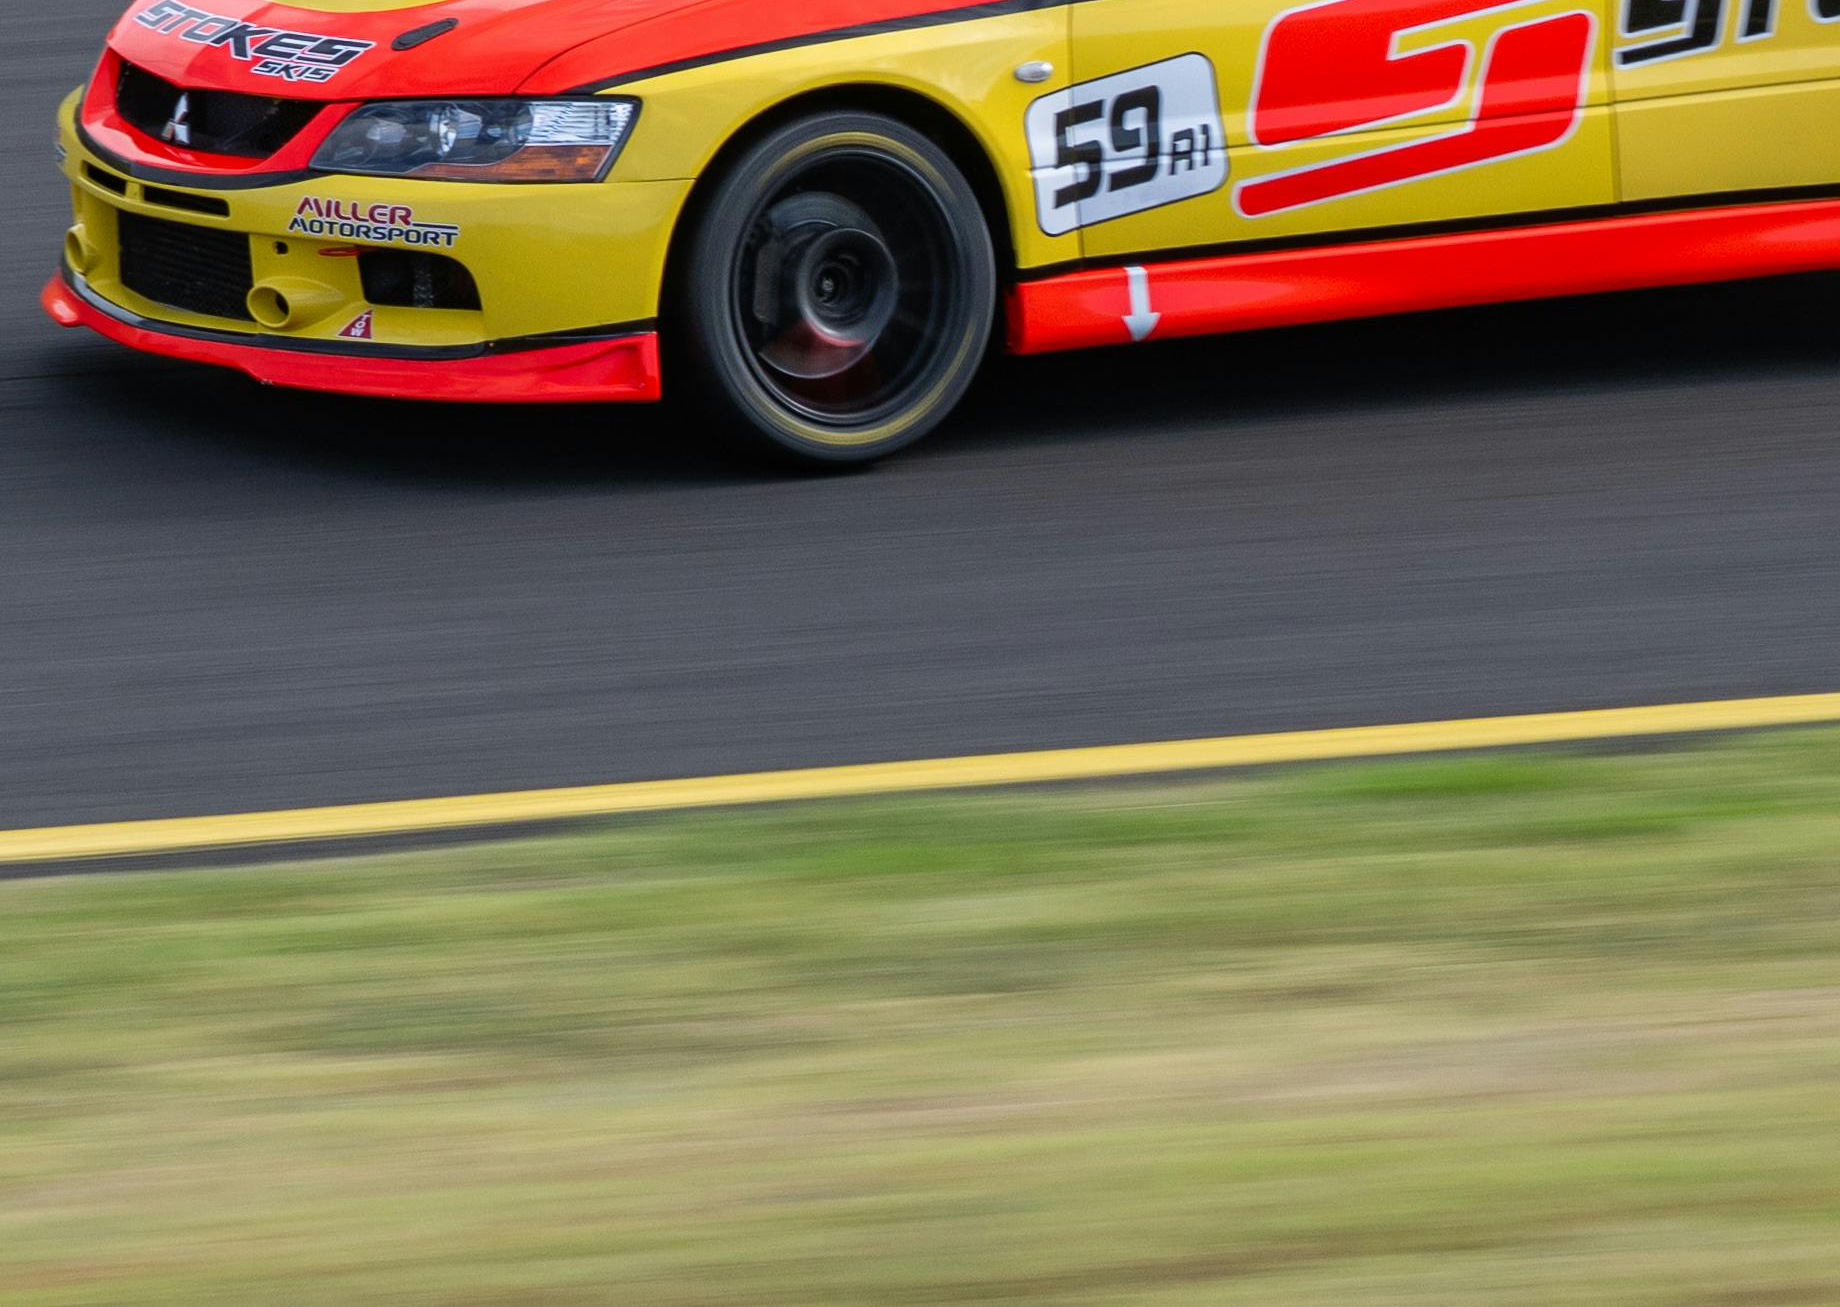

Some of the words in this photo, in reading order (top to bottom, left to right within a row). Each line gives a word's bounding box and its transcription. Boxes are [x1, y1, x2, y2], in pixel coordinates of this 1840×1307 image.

[250, 58, 339, 82] SKIS
[1052, 85, 1161, 209] 59
[296, 196, 412, 226] MILLER
[288, 217, 458, 246] MOTORSPORT
[351, 314, 370, 336] TOW
